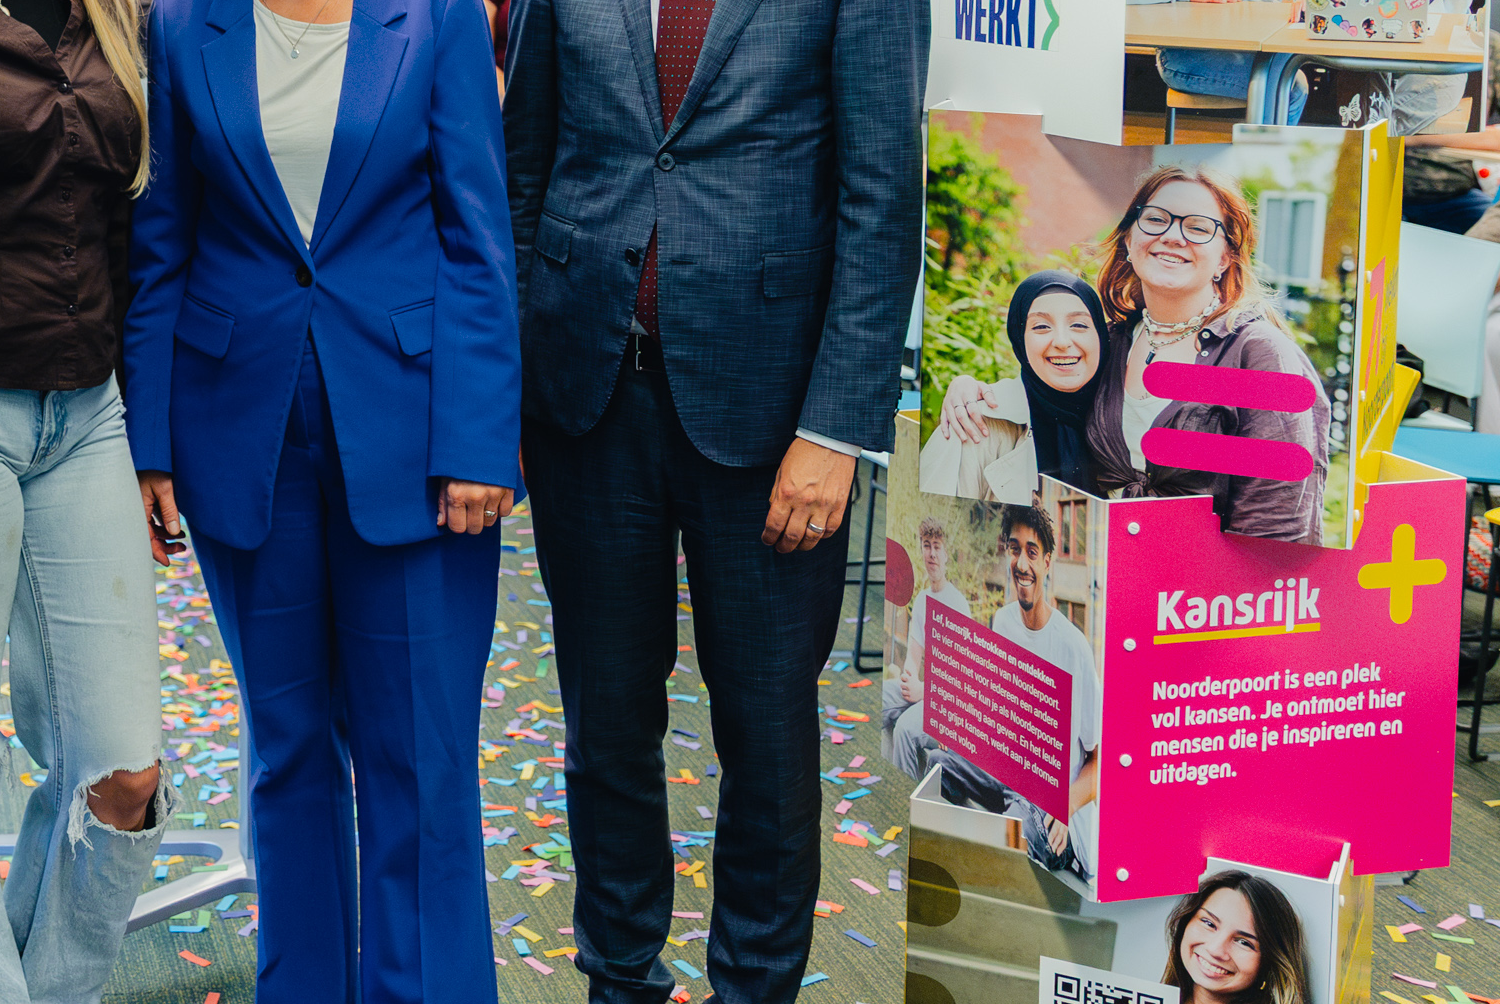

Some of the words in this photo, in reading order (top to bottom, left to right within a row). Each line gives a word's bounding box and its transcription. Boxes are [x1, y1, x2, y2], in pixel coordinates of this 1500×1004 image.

[1157, 577, 1321, 633] Kansrijk
[932, 610, 944, 627] Lef,
[945, 617, 972, 642] kansrijk,
[974, 632, 1007, 660] betrokken
[1008, 653, 1017, 666] en
[1018, 659, 1056, 689] ontdekken.
[932, 628, 941, 641] De
[942, 634, 953, 647] vier
[954, 642, 998, 673] merkwaarden
[999, 668, 1011, 681] van
[1012, 674, 1060, 711] Noorderpoort.
[1153, 671, 1281, 700] Noorderpoort
[1285, 669, 1300, 690] is
[1303, 669, 1338, 688] een
[1341, 662, 1381, 690] plek
[931, 662, 963, 691] betekenis.
[964, 683, 977, 698] Hier
[979, 690, 990, 706] kun
[991, 699, 998, 711] je
[999, 704, 1009, 718] als
[1010, 710, 1063, 751] Noorderpoorter
[932, 645, 960, 670] Woorden
[961, 665, 974, 678] met
[975, 673, 989, 687] voor
[990, 680, 1019, 704] iedereen
[1020, 699, 1033, 714] een
[1034, 705, 1058, 729] andere
[1151, 707, 1181, 728] vol
[1185, 705, 1256, 726] kansen.
[1260, 700, 1283, 719] Je
[1286, 691, 1366, 717] ontmoet
[1368, 687, 1406, 710] hier
[930, 681, 937, 693] je
[938, 686, 954, 704] eigen
[956, 694, 982, 722] invulling
[983, 714, 995, 727] aan
[996, 722, 1018, 743] geven.
[1019, 735, 1029, 748] En
[1030, 741, 1041, 755] het
[1042, 748, 1061, 770] leuke
[930, 717, 938, 728] en
[939, 721, 957, 742] groeit
[958, 733, 977, 754] volop.
[939, 705, 947, 717] Je
[947, 709, 964, 730] grijpt
[965, 720, 990, 744] kansen,
[991, 737, 1009, 756] werkt
[1010, 750, 1023, 764] aan
[1023, 757, 1031, 770] je
[1032, 763, 1058, 787] dromen
[1150, 735, 1225, 757] mensen
[1228, 728, 1258, 750] die
[1261, 726, 1279, 752] je
[1283, 721, 1376, 748] inspireren
[1380, 719, 1403, 736] en
[1150, 762, 1237, 785] uitdagen.
